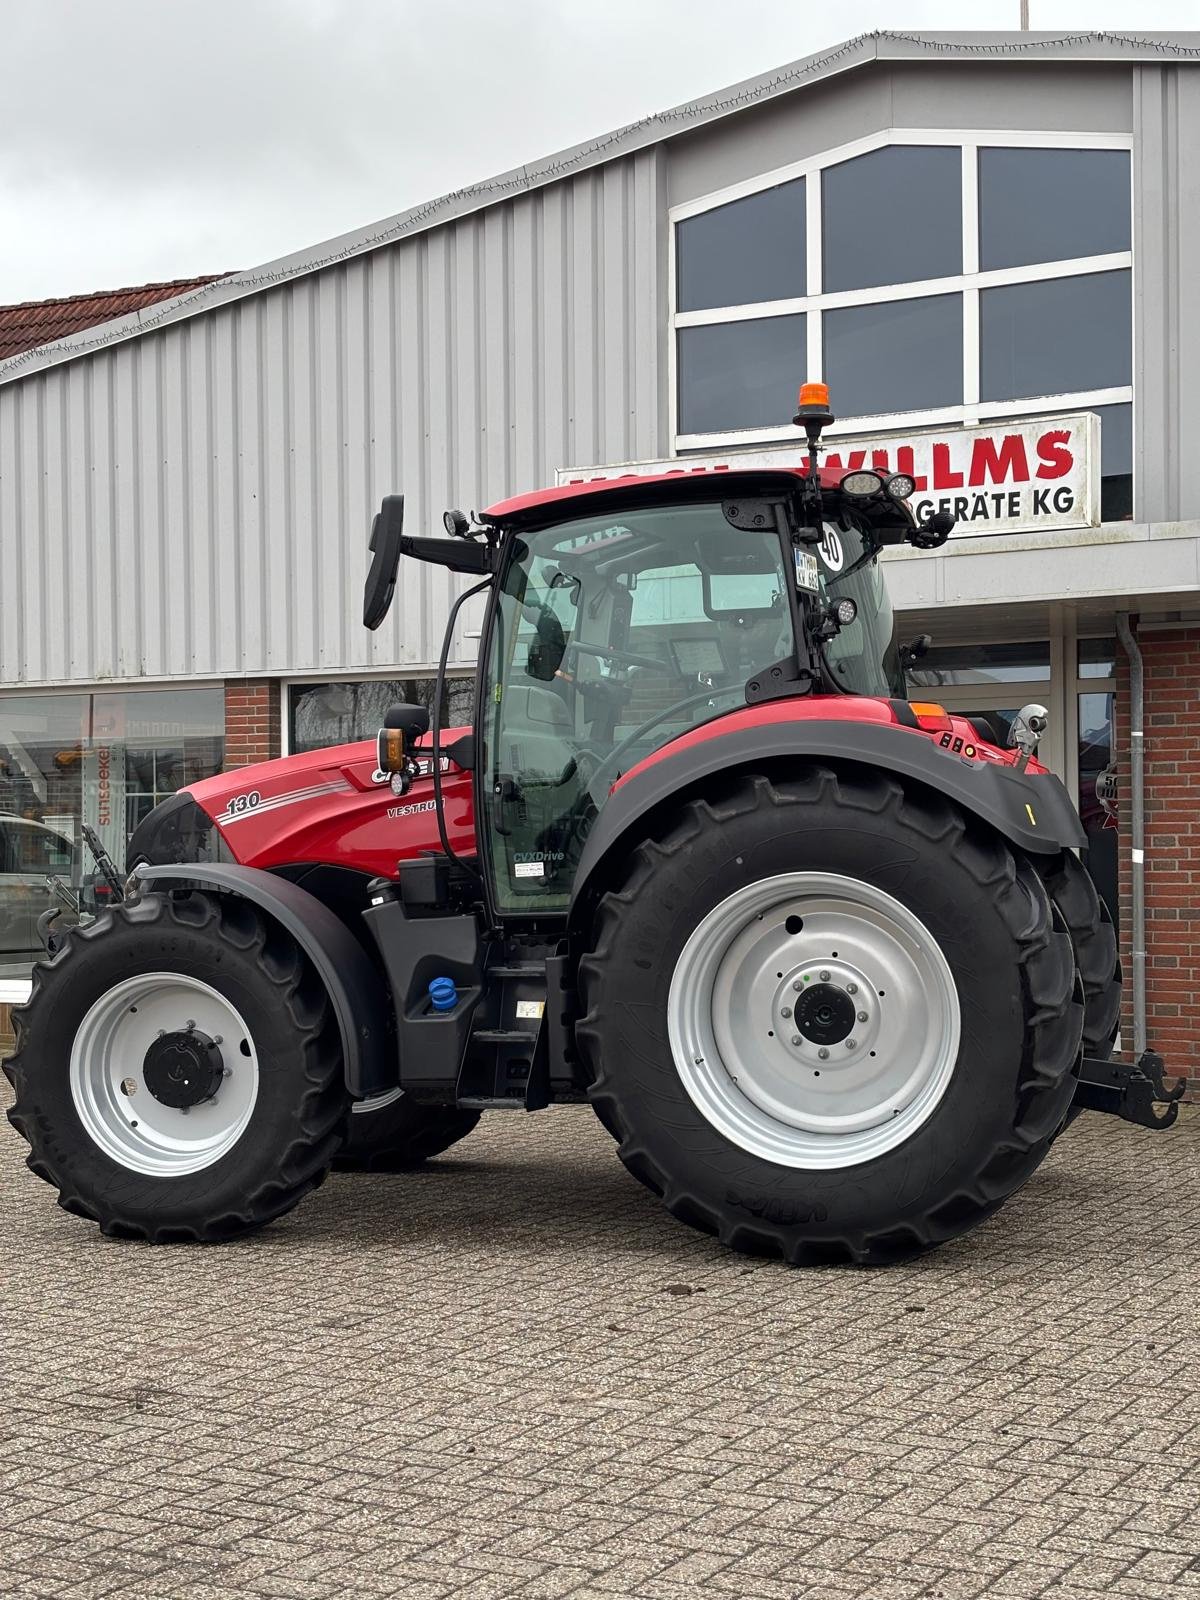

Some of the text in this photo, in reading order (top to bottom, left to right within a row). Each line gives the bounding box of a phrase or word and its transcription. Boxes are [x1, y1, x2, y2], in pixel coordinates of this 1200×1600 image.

[1033, 486, 1074, 516] KG
[821, 531, 839, 563] 40
[226, 790, 261, 816] 130
[513, 850, 565, 862] CVXDrive
